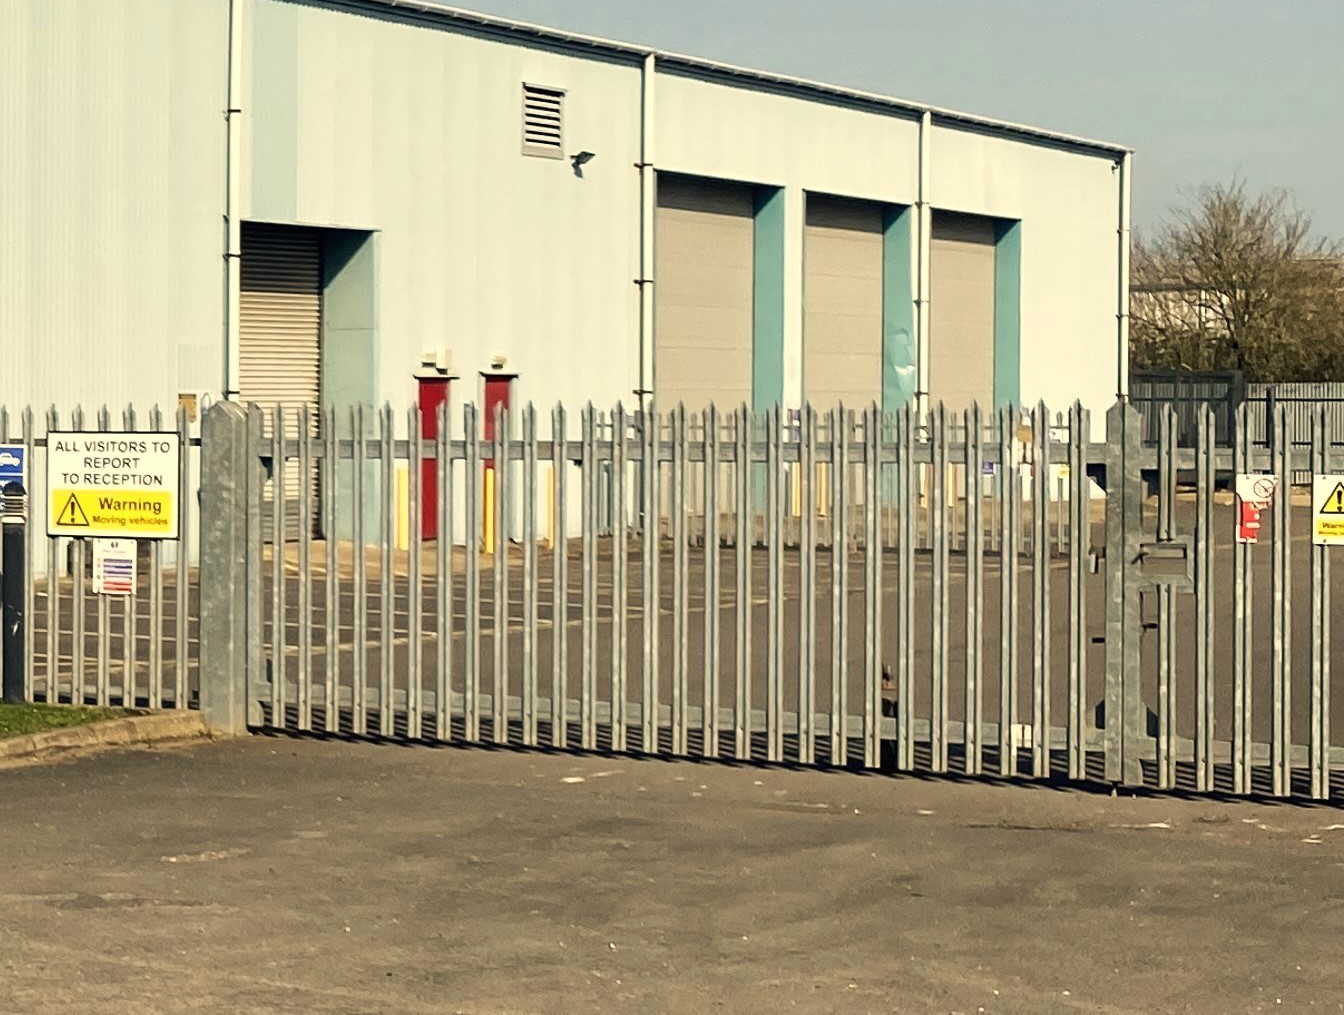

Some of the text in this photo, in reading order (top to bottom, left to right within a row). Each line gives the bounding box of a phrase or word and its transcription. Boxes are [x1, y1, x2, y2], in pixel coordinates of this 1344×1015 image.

[55, 441, 171, 453] ALL VISITORS TO
[84, 457, 140, 469] REPORT
[62, 473, 163, 486] TO RECEPTION
[99, 497, 162, 515] Warning
[93, 516, 168, 526] Moving vehicles
